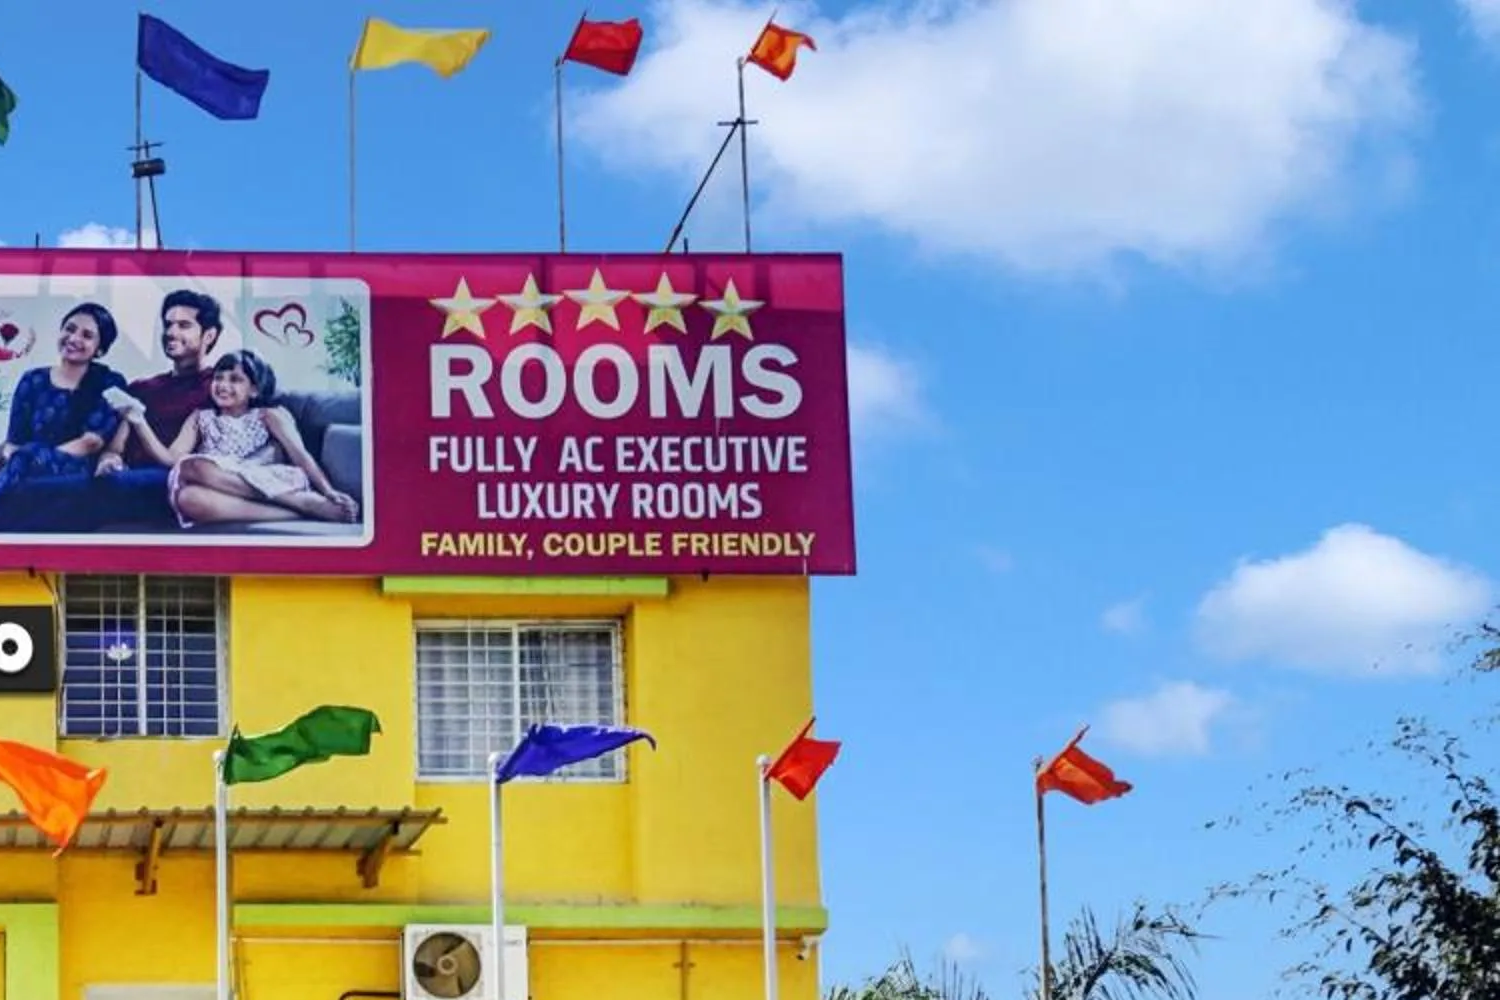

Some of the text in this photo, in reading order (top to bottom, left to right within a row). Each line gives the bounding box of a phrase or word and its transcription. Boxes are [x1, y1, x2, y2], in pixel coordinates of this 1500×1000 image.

[429, 342, 803, 420] ROOMS
[429, 436, 808, 473] FULLY AC EXECUTIVE
[477, 482, 762, 519] LUXURY ROOMS
[421, 532, 816, 560] FAMILY, COUPLE FRIENDLY
